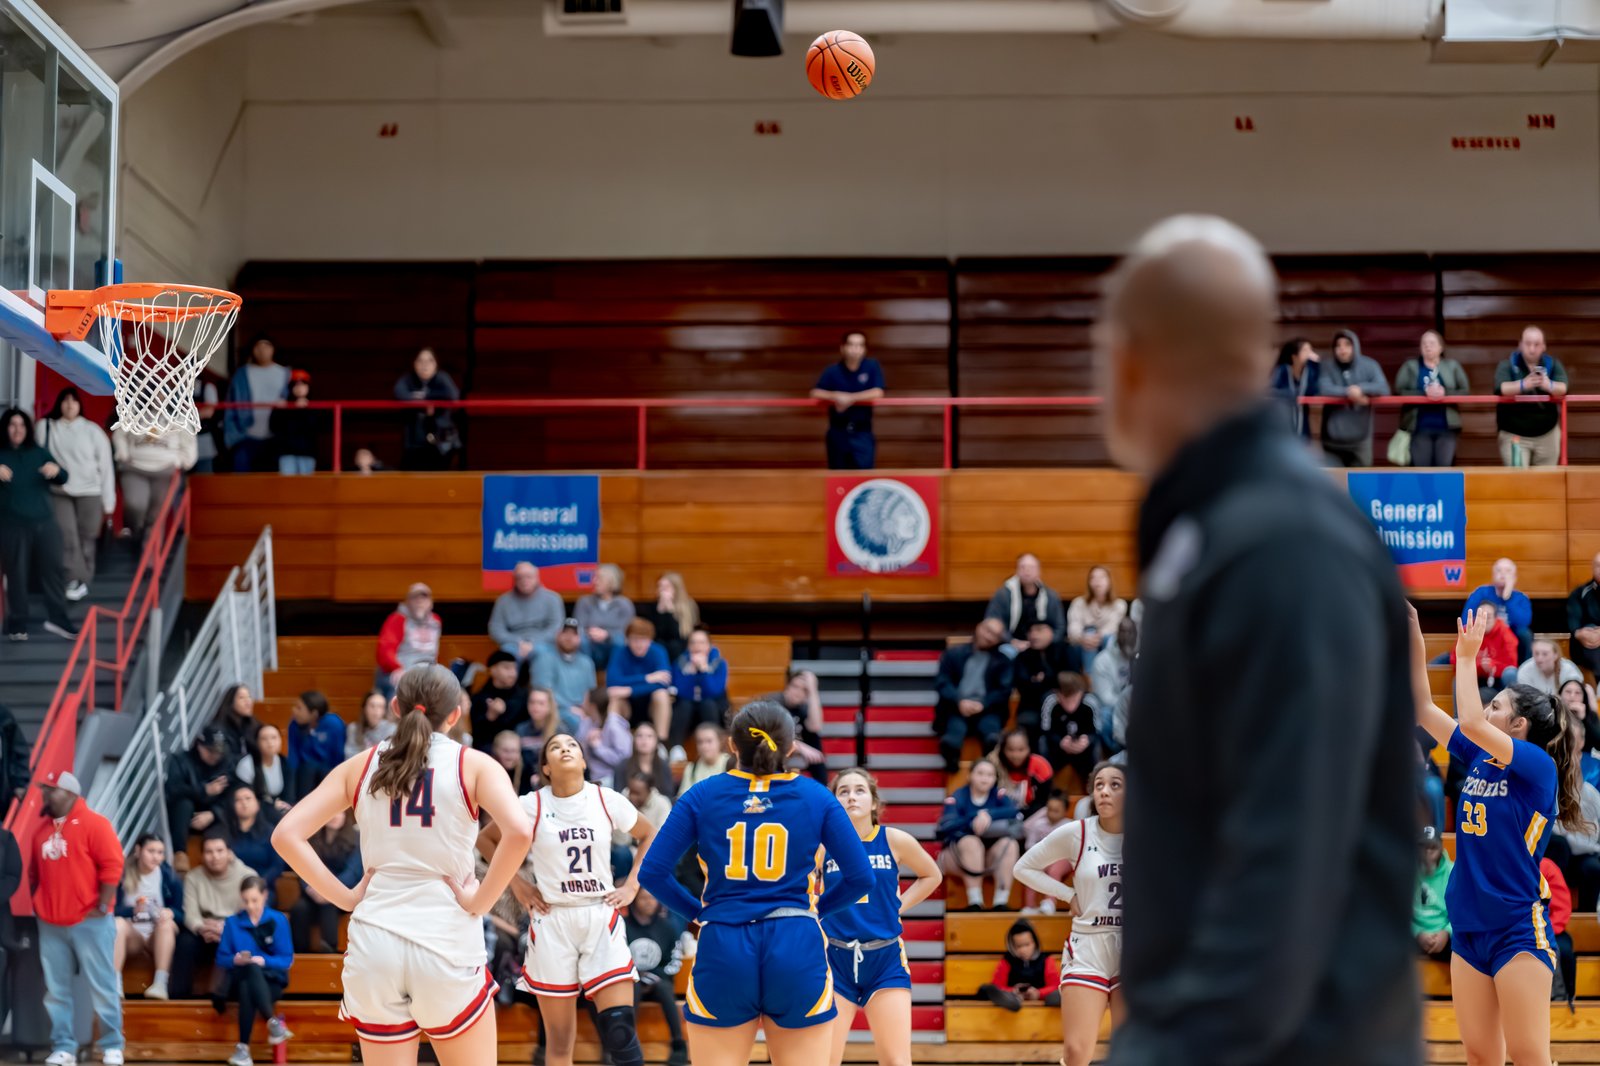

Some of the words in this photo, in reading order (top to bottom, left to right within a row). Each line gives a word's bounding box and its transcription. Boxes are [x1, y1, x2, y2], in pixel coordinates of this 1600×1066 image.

[504, 502, 577, 526] General
[1370, 499, 1442, 523] General
[493, 528, 588, 551] Admission
[1376, 526, 1455, 549] mission
[1443, 565, 1462, 584] W
[389, 767, 435, 828] 14
[1461, 800, 1488, 836] 33
[558, 827, 595, 844] WEST
[566, 845, 592, 874] 21
[724, 821, 789, 882] 10
[1097, 863, 1123, 879] WES
[561, 878, 606, 894] AURORA
